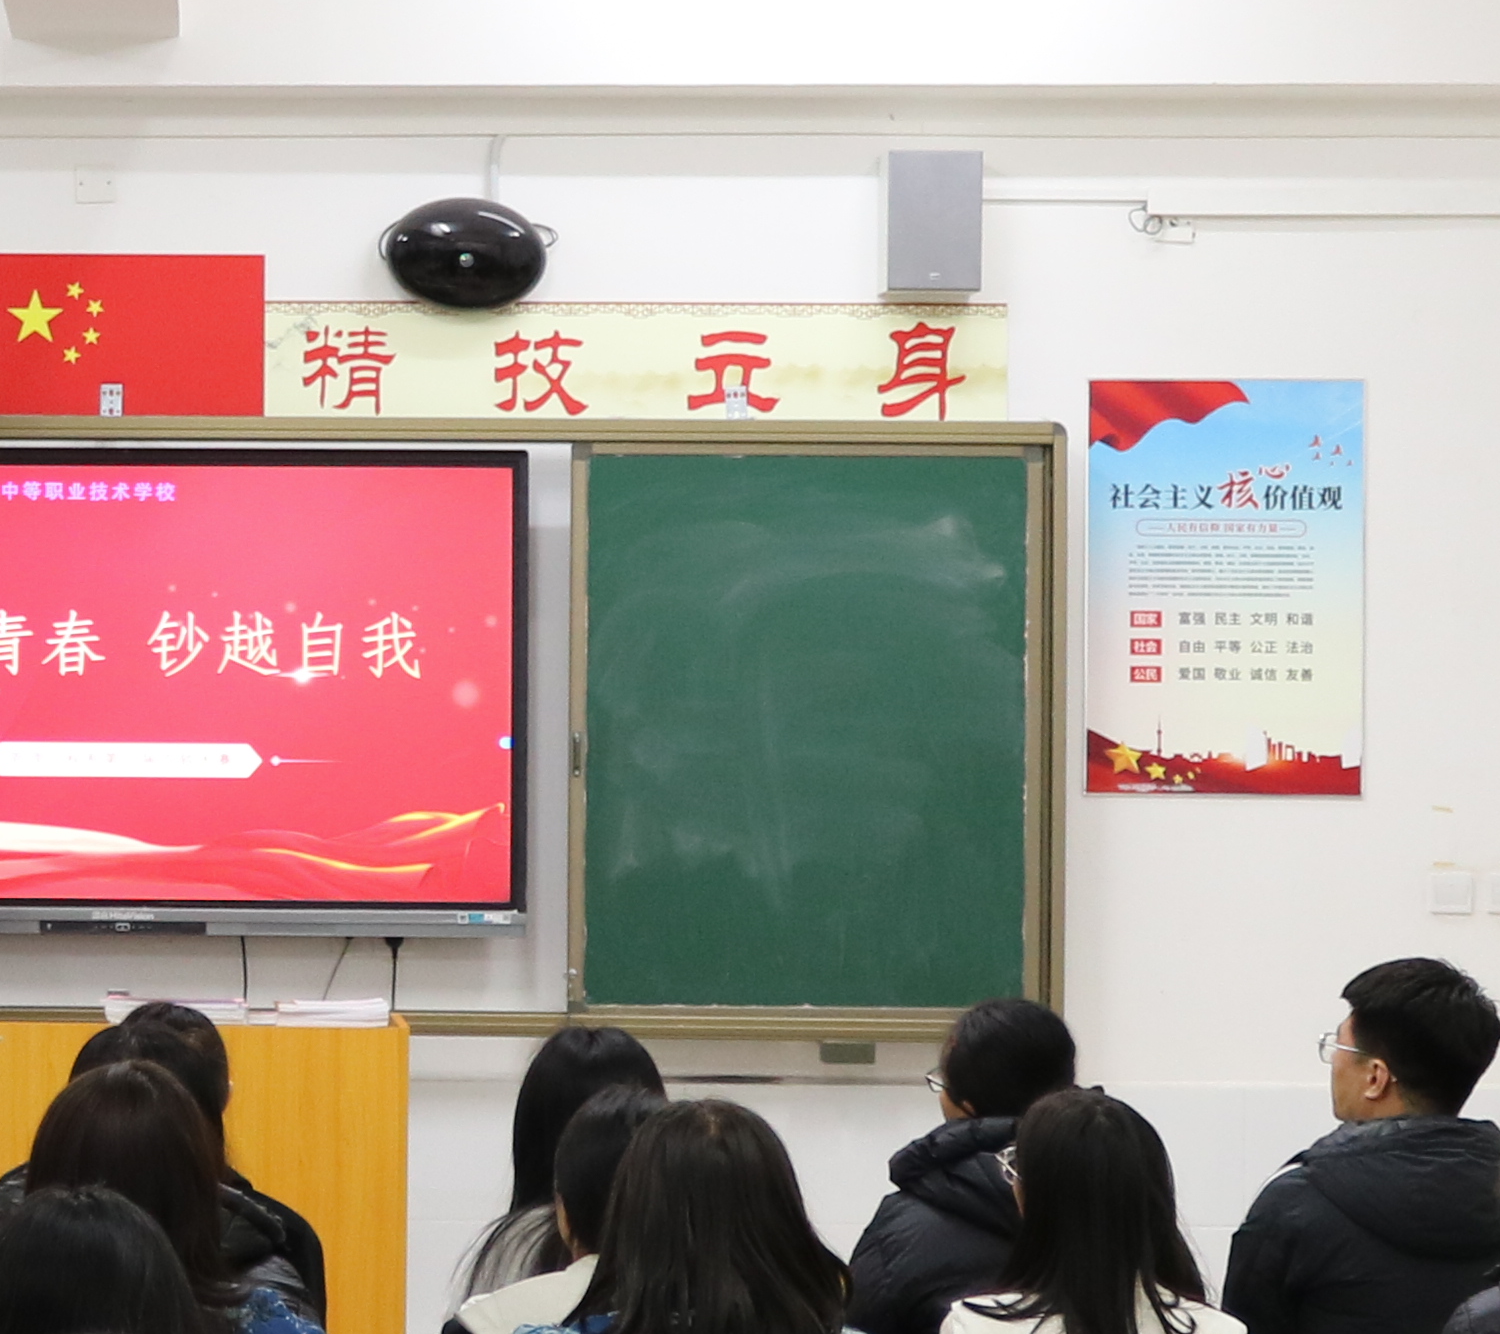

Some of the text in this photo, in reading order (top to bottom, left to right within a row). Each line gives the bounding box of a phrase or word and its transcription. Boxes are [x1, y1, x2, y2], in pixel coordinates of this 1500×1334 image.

[302, 321, 967, 421] 精技立身
[1109, 463, 1344, 511] 社会主义核心价值观
[1178, 612, 1206, 626] 富强
[1214, 612, 1242, 626] 民主
[1250, 612, 1278, 626] 文明
[146, 609, 422, 680] 钞越自我
[1133, 640, 1314, 654] 社会 自由 平等 公正 法治
[1133, 668, 1158, 682] 公民
[1178, 668, 1206, 682] 爱国
[1214, 668, 1242, 682] 敬业
[1286, 668, 1314, 682] 友善
